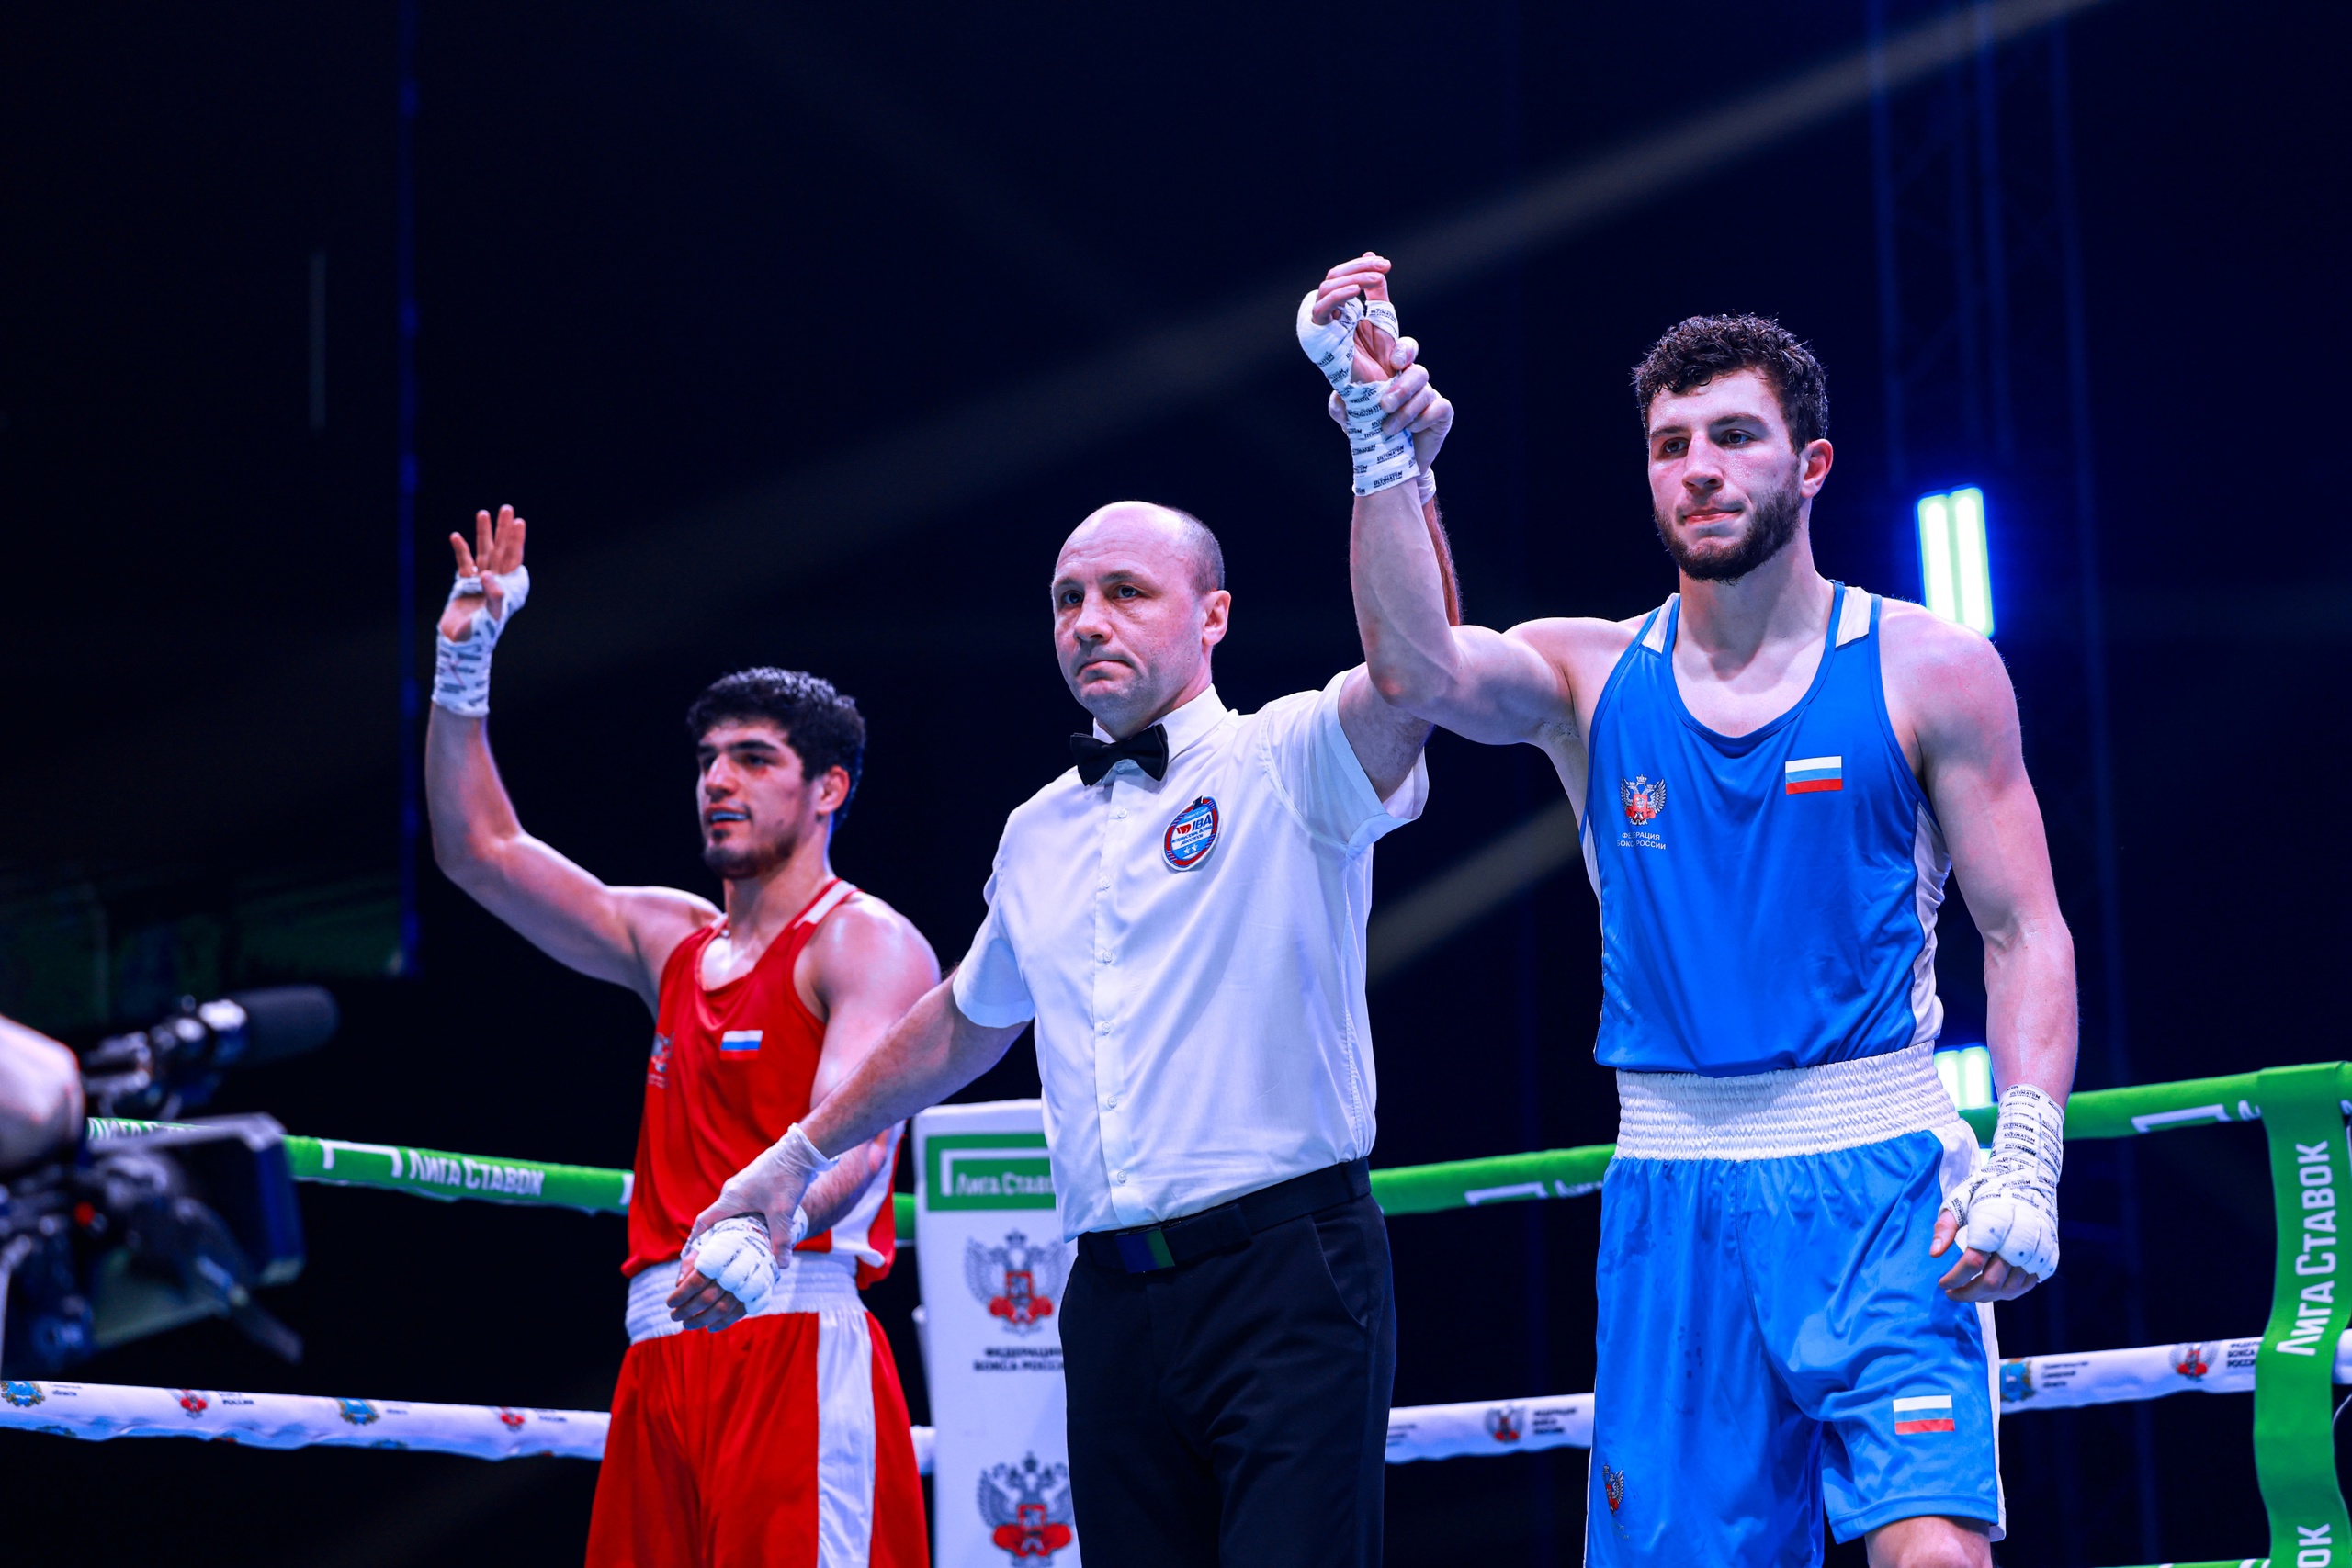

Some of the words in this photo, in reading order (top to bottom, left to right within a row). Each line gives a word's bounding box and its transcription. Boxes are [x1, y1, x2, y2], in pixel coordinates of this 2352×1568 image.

[1376, 445, 1405, 461] ULTIMATUM
[1373, 470, 1403, 486] ULTIMATUM
[1192, 814, 1212, 832] IBA
[1622, 831, 1660, 840] ФЕЕРАЦИЯ
[1635, 840, 1667, 850] РОССИИ
[2009, 1089, 2041, 1100] ULTIMATUM
[2004, 1132, 2036, 1143] ULTIMATUM
[462, 1157, 545, 1197] СТАВОК
[2295, 1140, 2336, 1276] СТАВОК
[2276, 1280, 2335, 1356] ЛИГА
